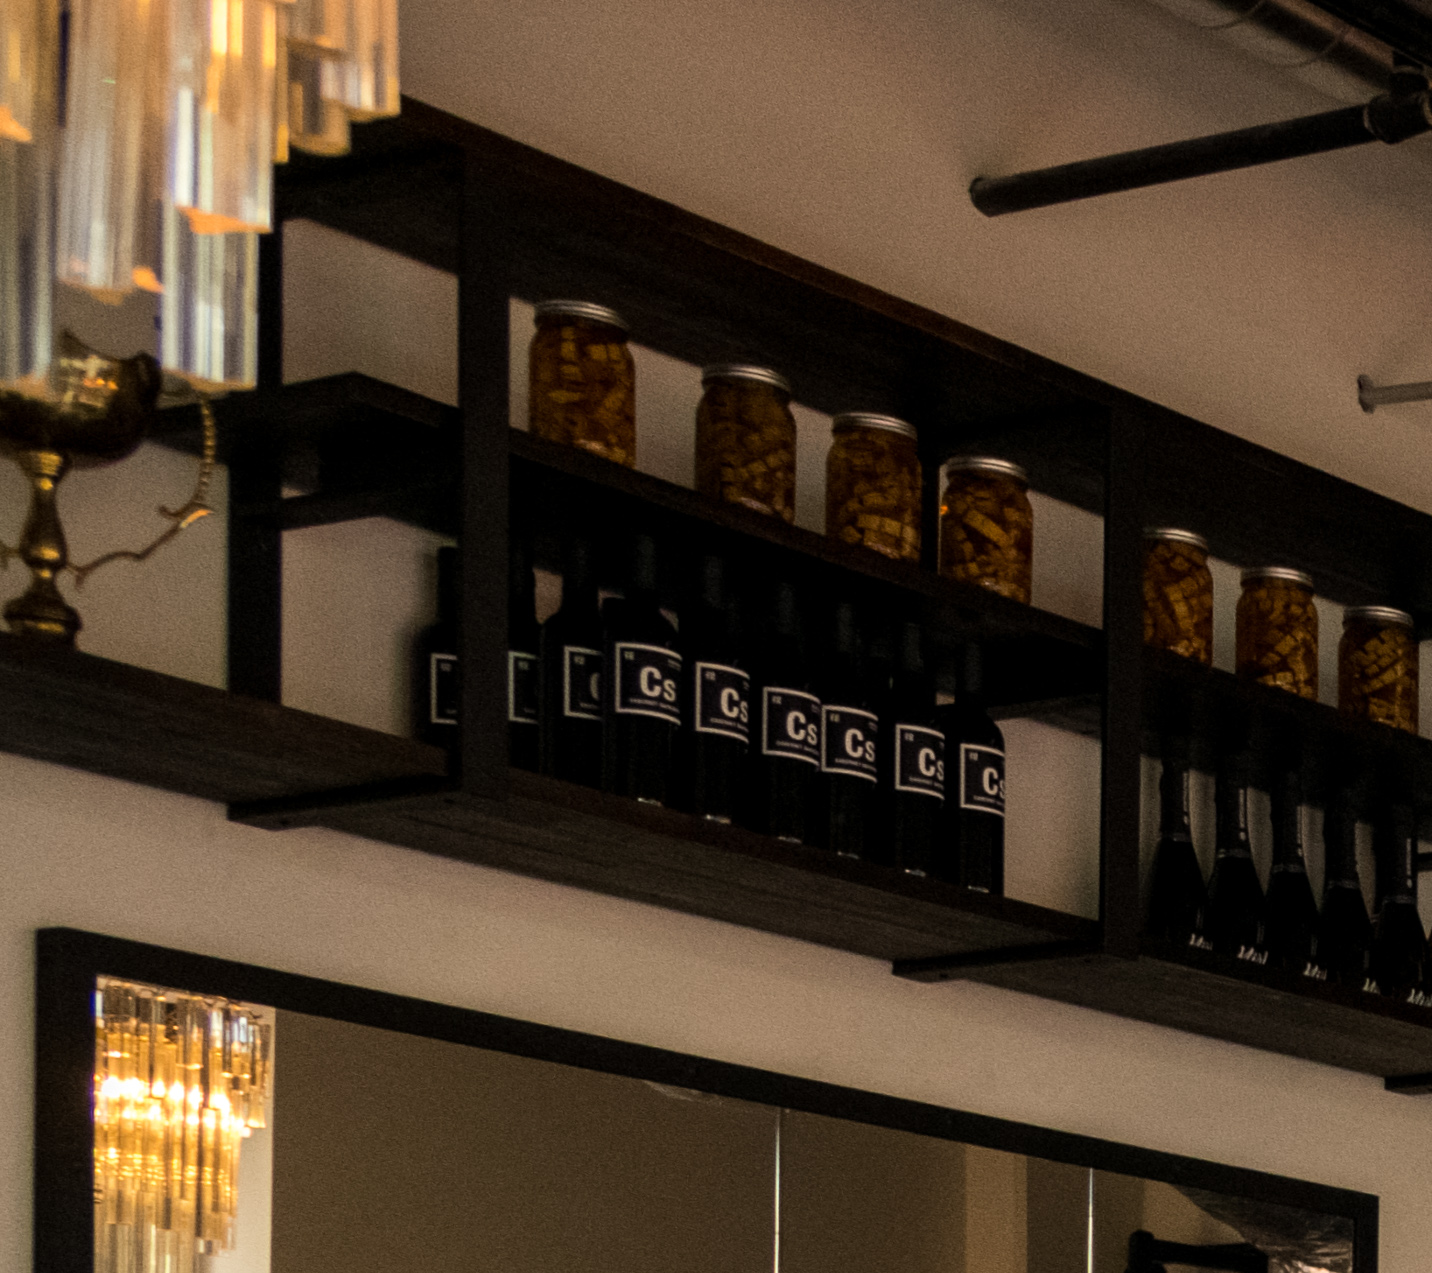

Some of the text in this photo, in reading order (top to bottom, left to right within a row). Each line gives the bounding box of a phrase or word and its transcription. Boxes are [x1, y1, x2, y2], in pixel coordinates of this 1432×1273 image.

[639, 665, 677, 703] Cs
[720, 687, 749, 723] Cs
[786, 710, 818, 747] Cs
[845, 728, 876, 763] Cs
